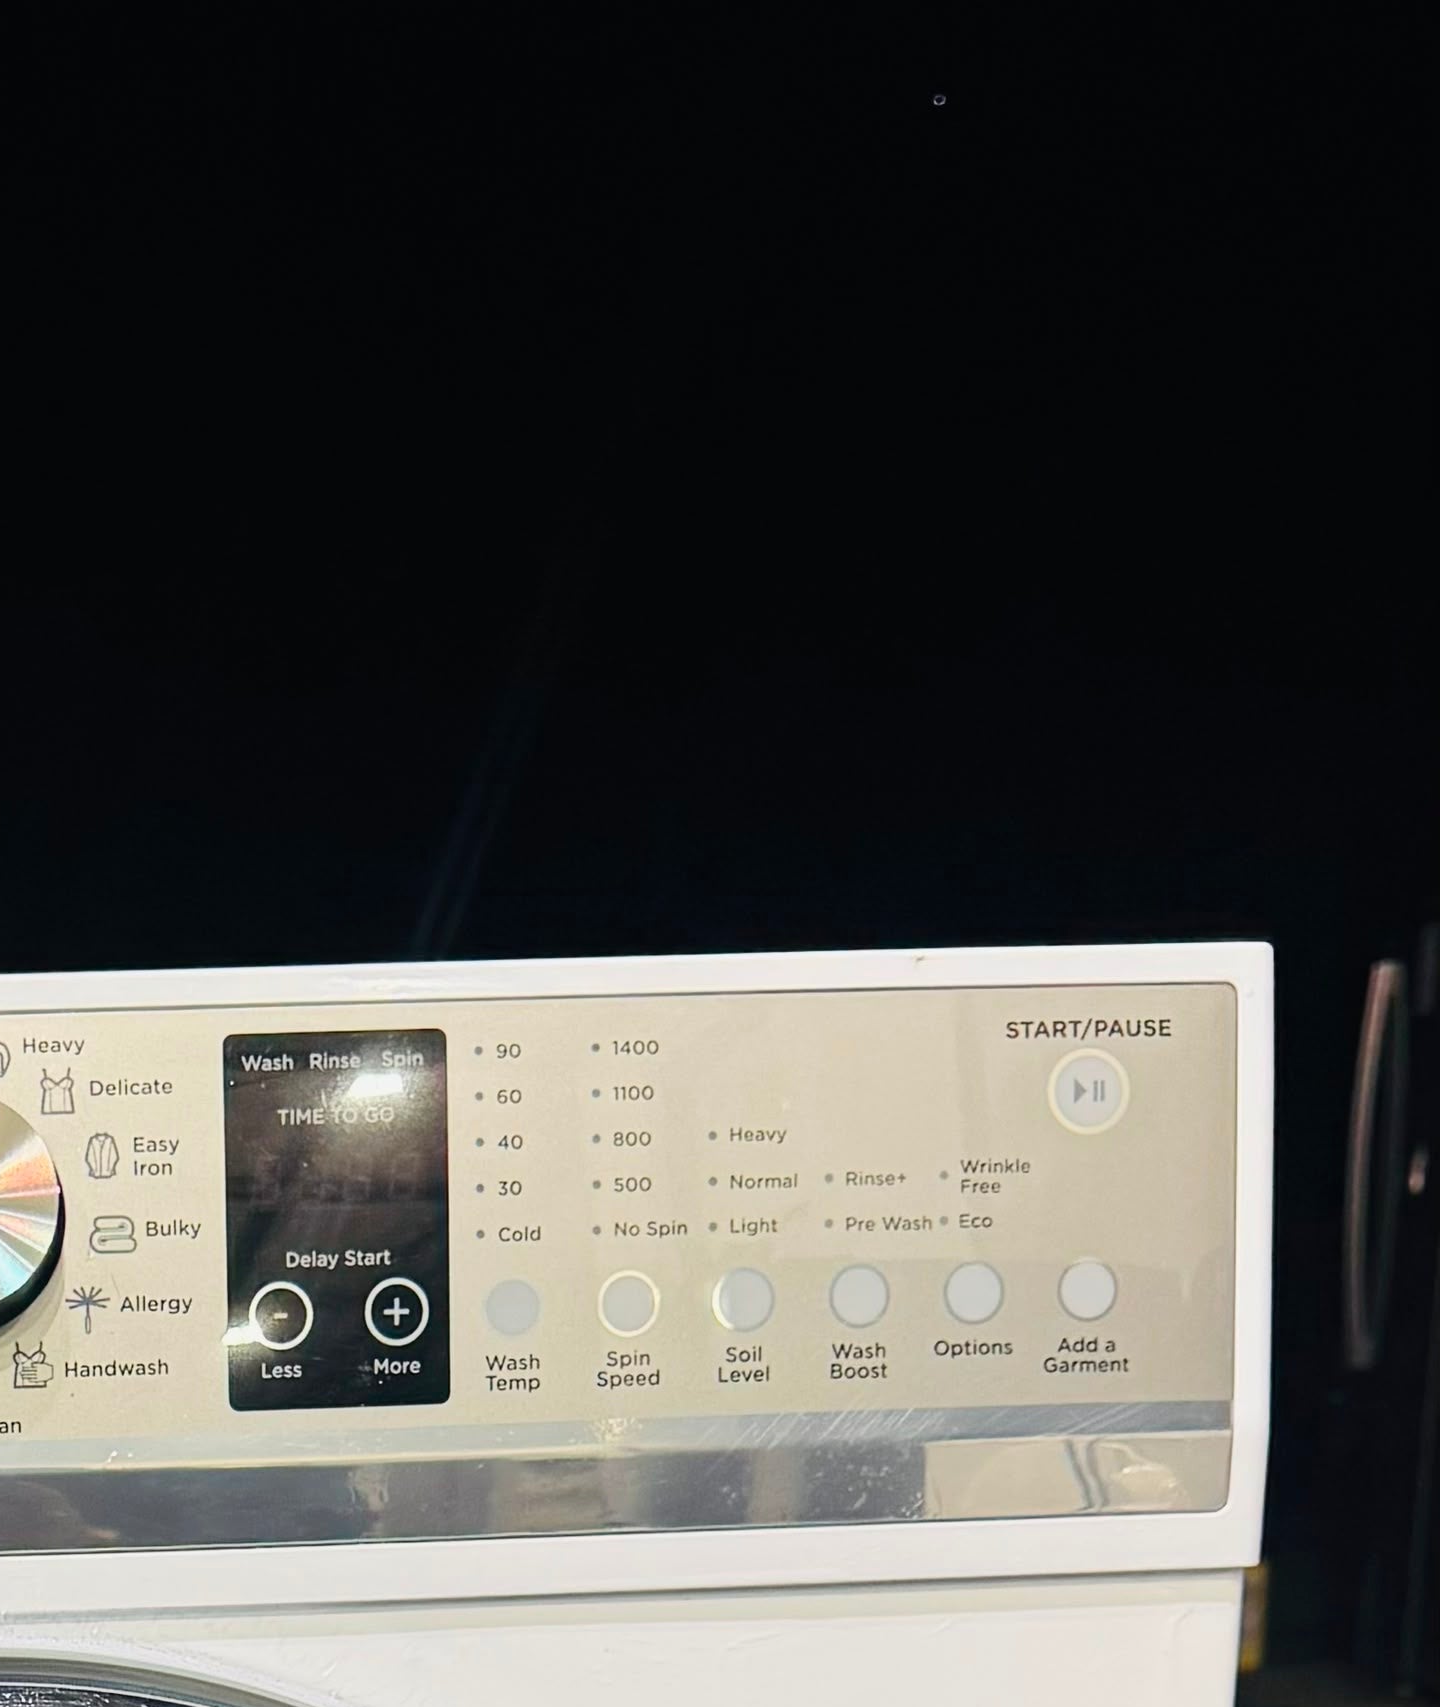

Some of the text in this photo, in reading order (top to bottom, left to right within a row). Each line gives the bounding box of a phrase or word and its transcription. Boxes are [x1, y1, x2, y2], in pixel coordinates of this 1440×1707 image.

[1005, 1019, 1172, 1040] START/PAUSE
[23, 1036, 85, 1057] Heavy
[497, 1043, 521, 1059] 90
[612, 1040, 659, 1056] 1400
[241, 1054, 294, 1072] Wash
[310, 1052, 360, 1072] Rinse
[382, 1051, 424, 1069] Spin
[89, 1078, 173, 1097] Delicate
[613, 1086, 654, 1101] 1100
[497, 1089, 522, 1104] 60
[277, 1107, 395, 1126] TIME TO GO
[498, 1135, 523, 1150] 40
[613, 1131, 651, 1147] 800
[729, 1127, 787, 1144] Heavy
[133, 1136, 179, 1158] Easy
[133, 1158, 173, 1177] Iron
[960, 1158, 1031, 1174] Wrinkle
[613, 1177, 651, 1192] 500
[729, 1173, 798, 1189] Normal
[846, 1171, 907, 1187] Rinse+
[960, 1179, 1001, 1194] Free
[498, 1181, 522, 1196] 30
[145, 1218, 201, 1241] Bulky
[614, 1220, 688, 1239] No Spin
[729, 1217, 778, 1235] Light
[846, 1215, 933, 1232] Pre Wash
[959, 1214, 993, 1229] Eco
[499, 1226, 541, 1242] Cold
[286, 1249, 391, 1270] Delay Start
[120, 1295, 193, 1316] Allergy
[832, 1343, 886, 1360] Wash
[934, 1339, 1013, 1358] Options
[1058, 1338, 1116, 1354] Add a
[485, 1354, 540, 1372] Wash
[606, 1351, 651, 1369] Spin
[726, 1347, 763, 1363] Soil
[64, 1358, 169, 1378] Handwash
[261, 1362, 302, 1379] Less
[373, 1358, 421, 1375] More
[830, 1363, 887, 1379] Boost
[1043, 1357, 1129, 1374] Garment
[597, 1370, 660, 1389] Speed
[718, 1366, 770, 1383] Level
[485, 1375, 541, 1393] Temp
